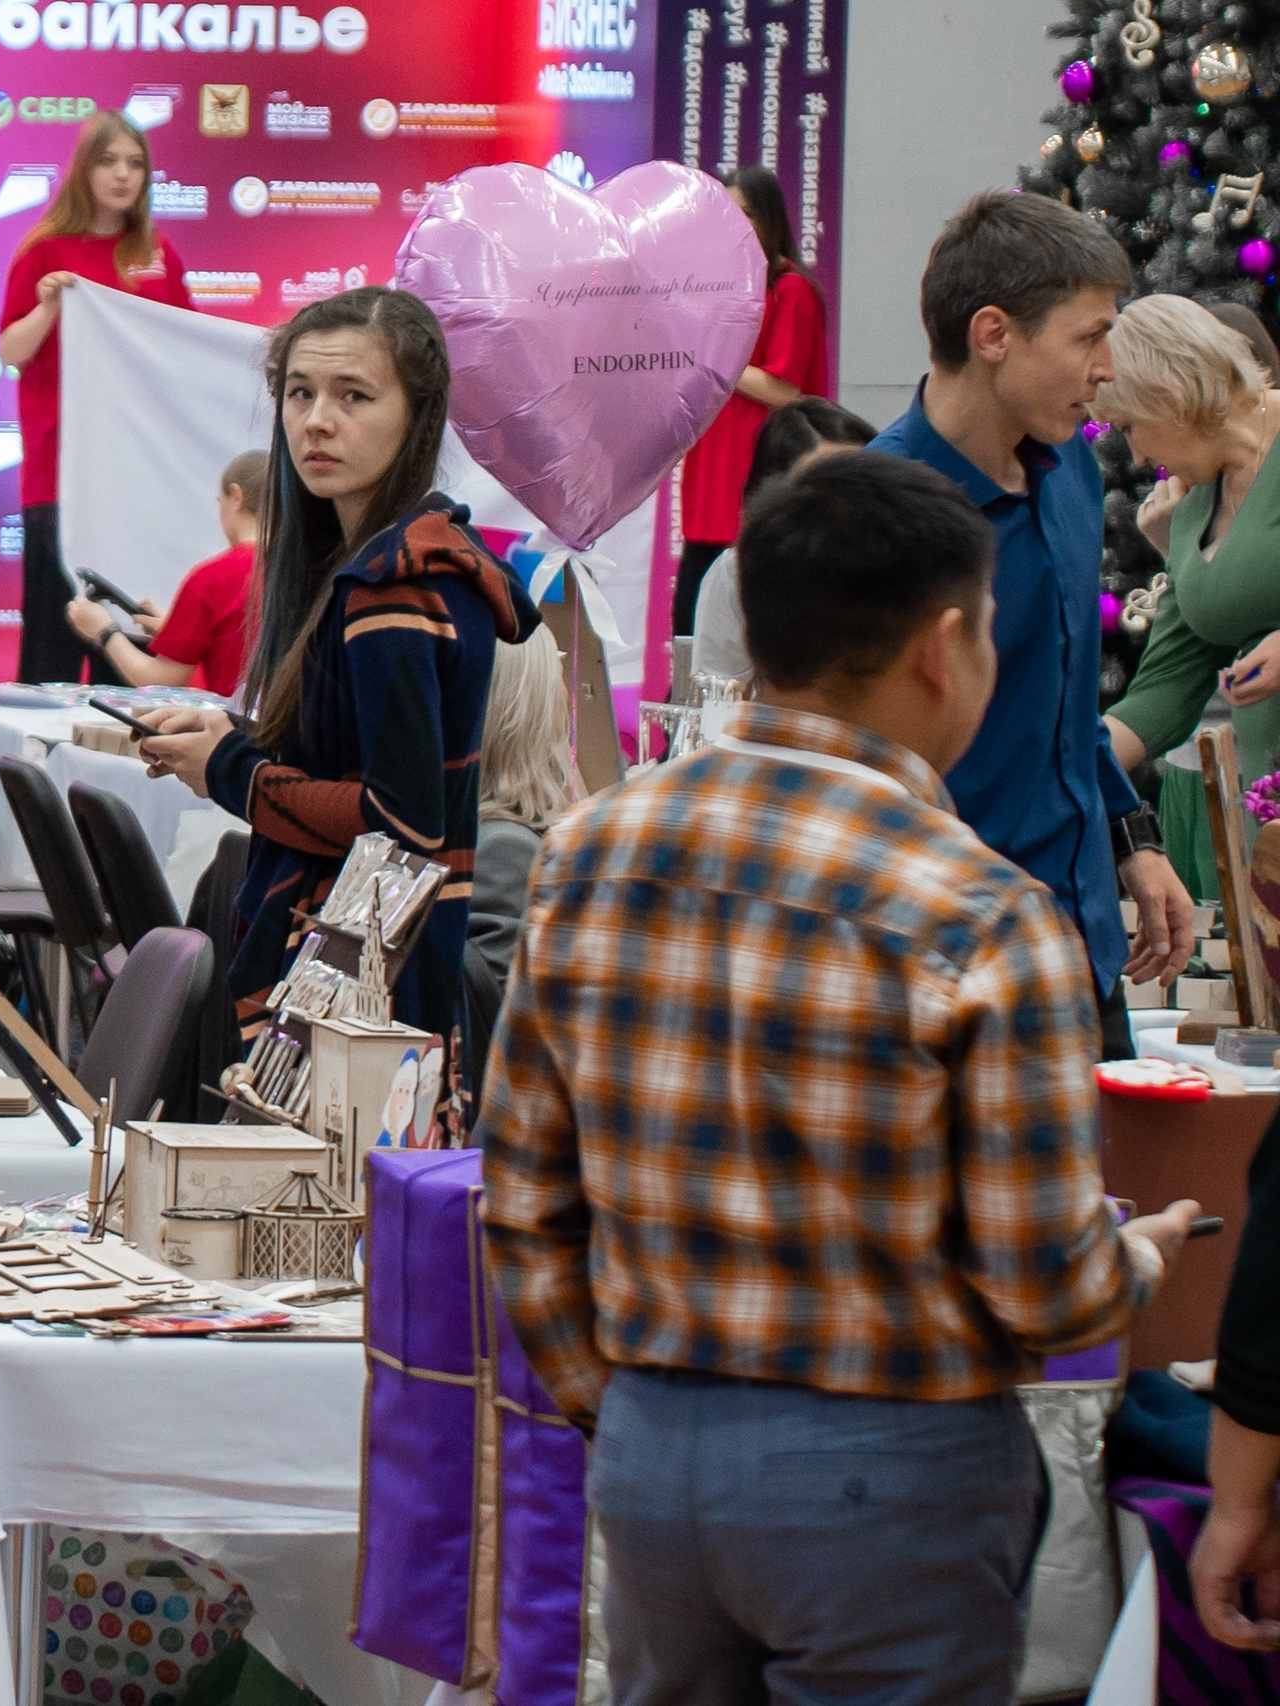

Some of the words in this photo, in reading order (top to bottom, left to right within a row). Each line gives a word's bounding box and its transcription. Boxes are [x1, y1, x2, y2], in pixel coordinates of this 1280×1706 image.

[539, 0, 637, 48] БИЗНЕС
[807, 0, 830, 70] имай
[19, 96, 96, 120] СБЕР
[762, 22, 788, 177] #тыможеш
[267, 114, 329, 125] БИЗНЕС
[799, 92, 829, 263] #развивайся
[152, 194, 207, 206] ИЗНЕС
[573, 351, 696, 375] ENDORPHIN
